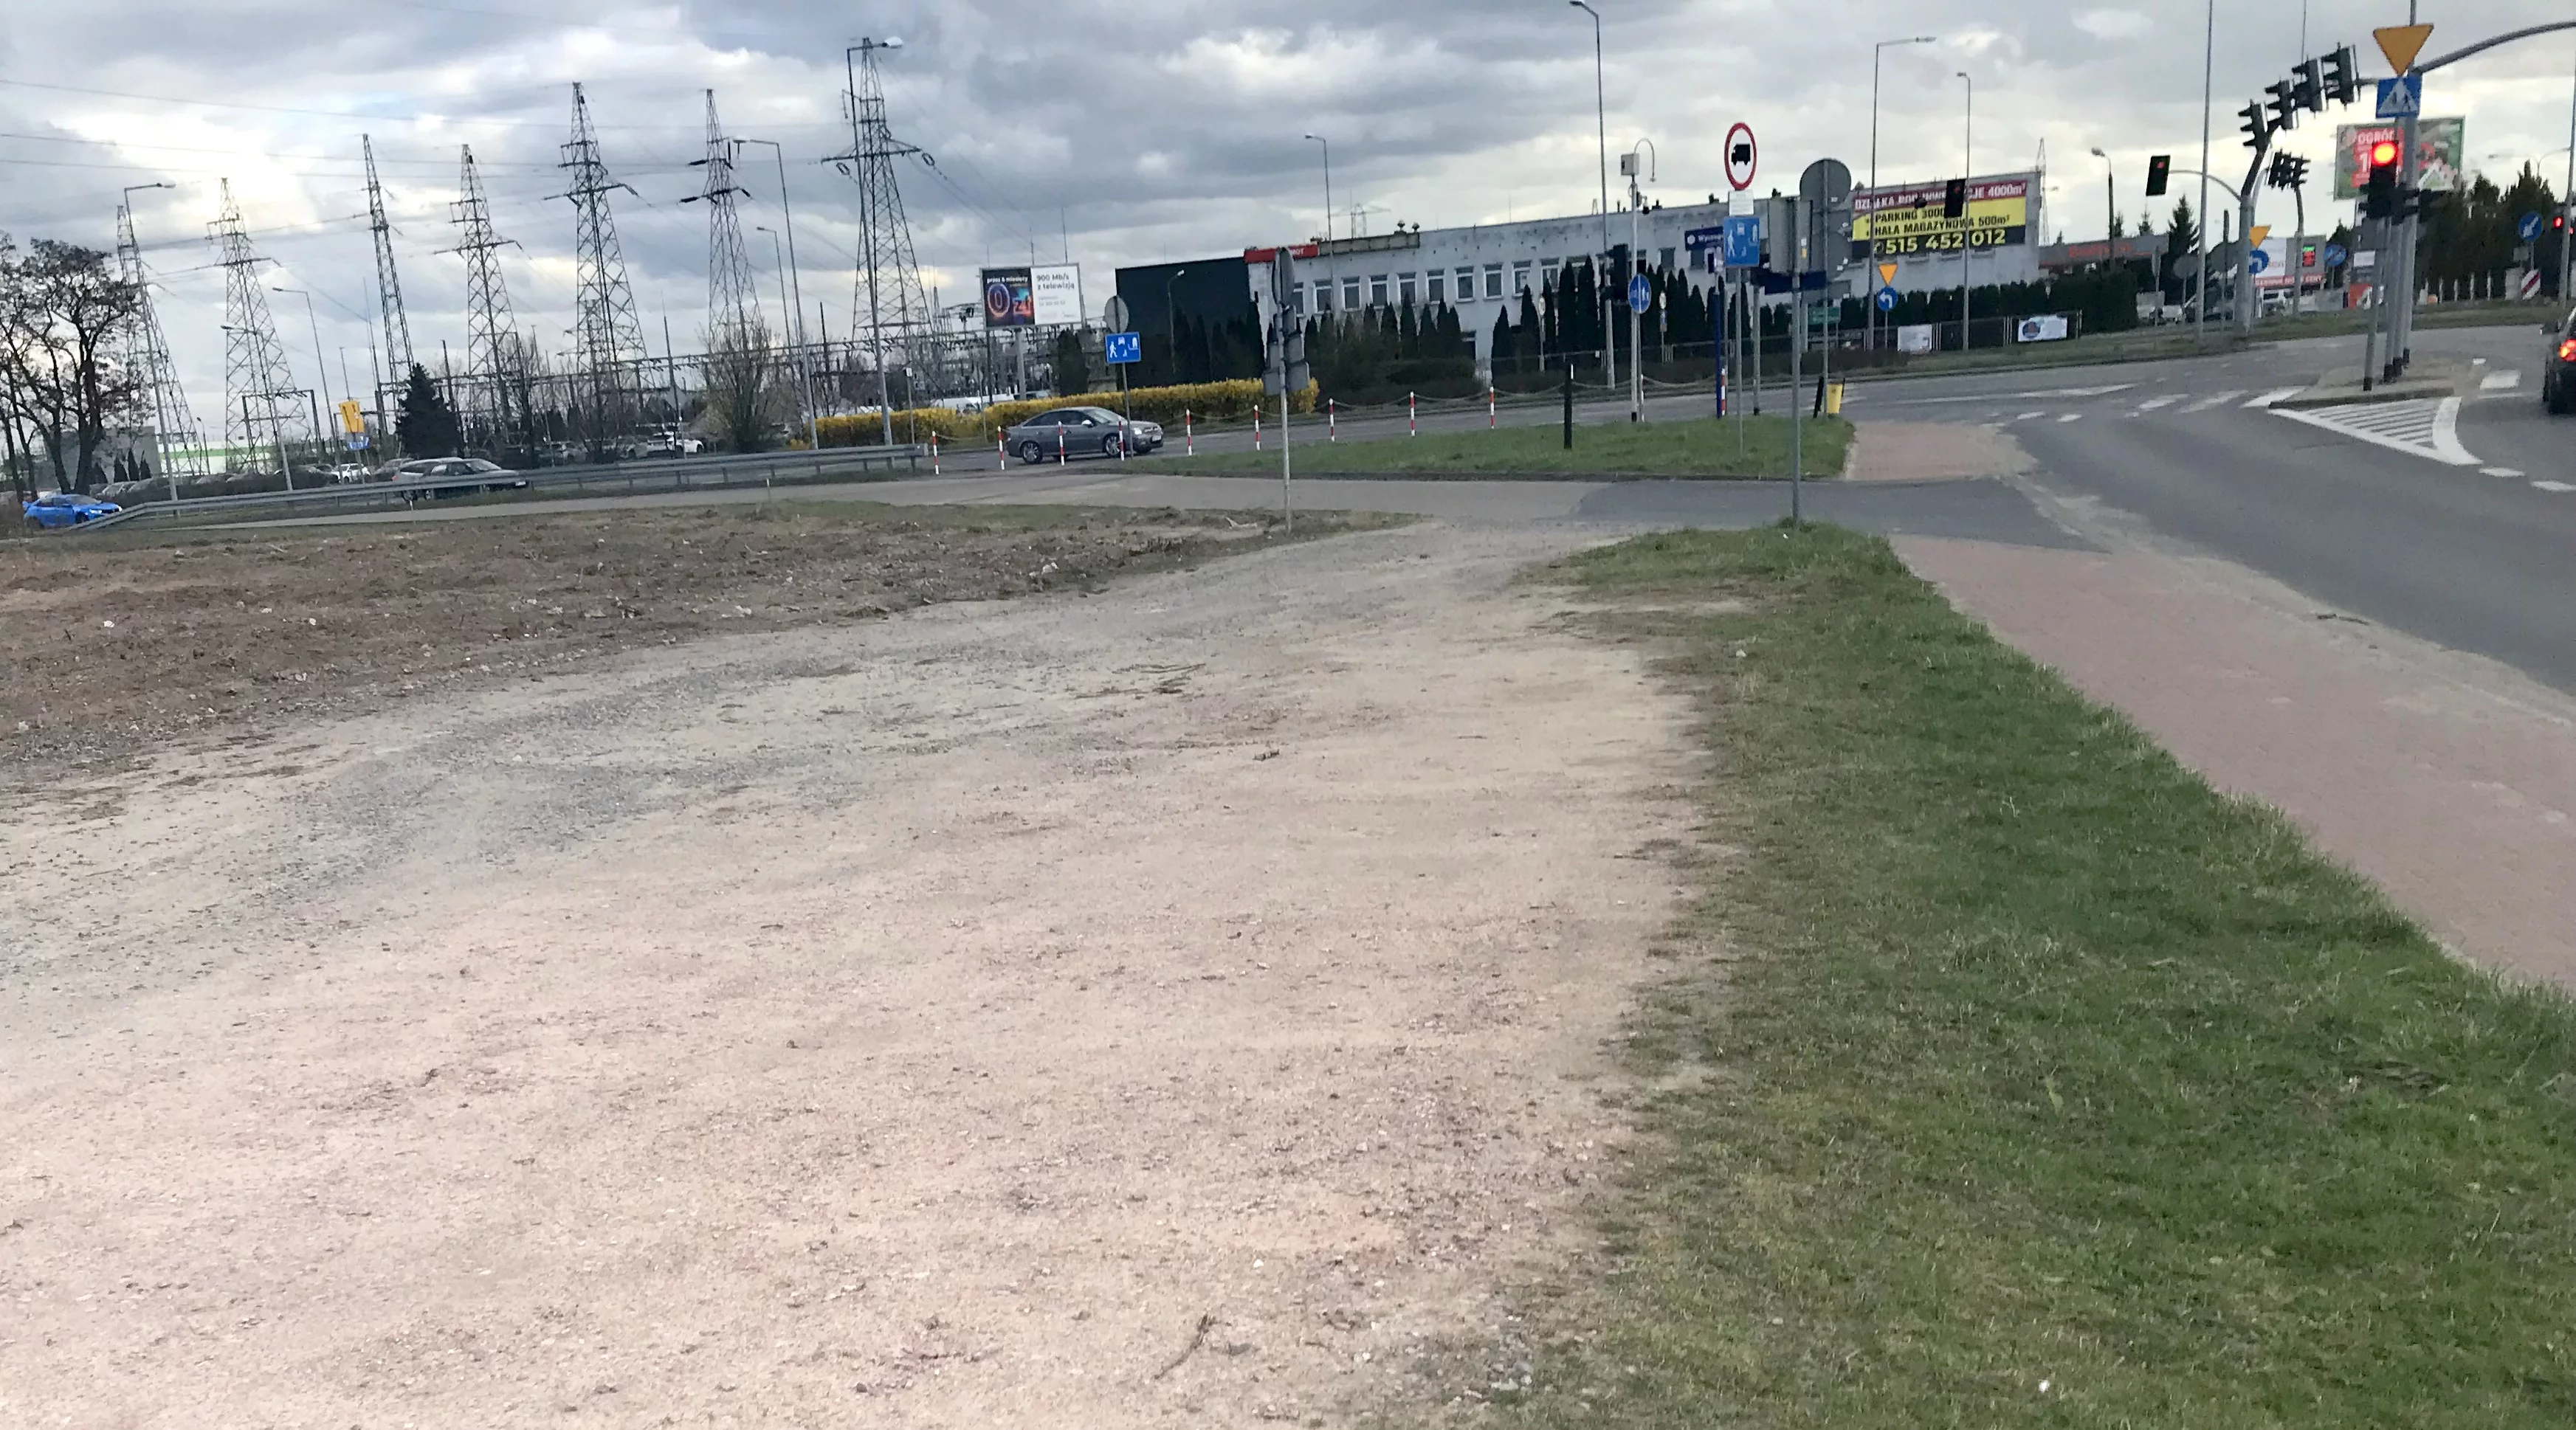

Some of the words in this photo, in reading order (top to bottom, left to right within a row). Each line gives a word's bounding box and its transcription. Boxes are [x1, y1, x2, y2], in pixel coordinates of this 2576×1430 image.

[1875, 210, 1918, 223] PARKING
[1875, 224, 1900, 236] HALA
[1886, 238, 1918, 255] 515
[1926, 232, 1963, 250] 452
[1971, 229, 2006, 246] 012
